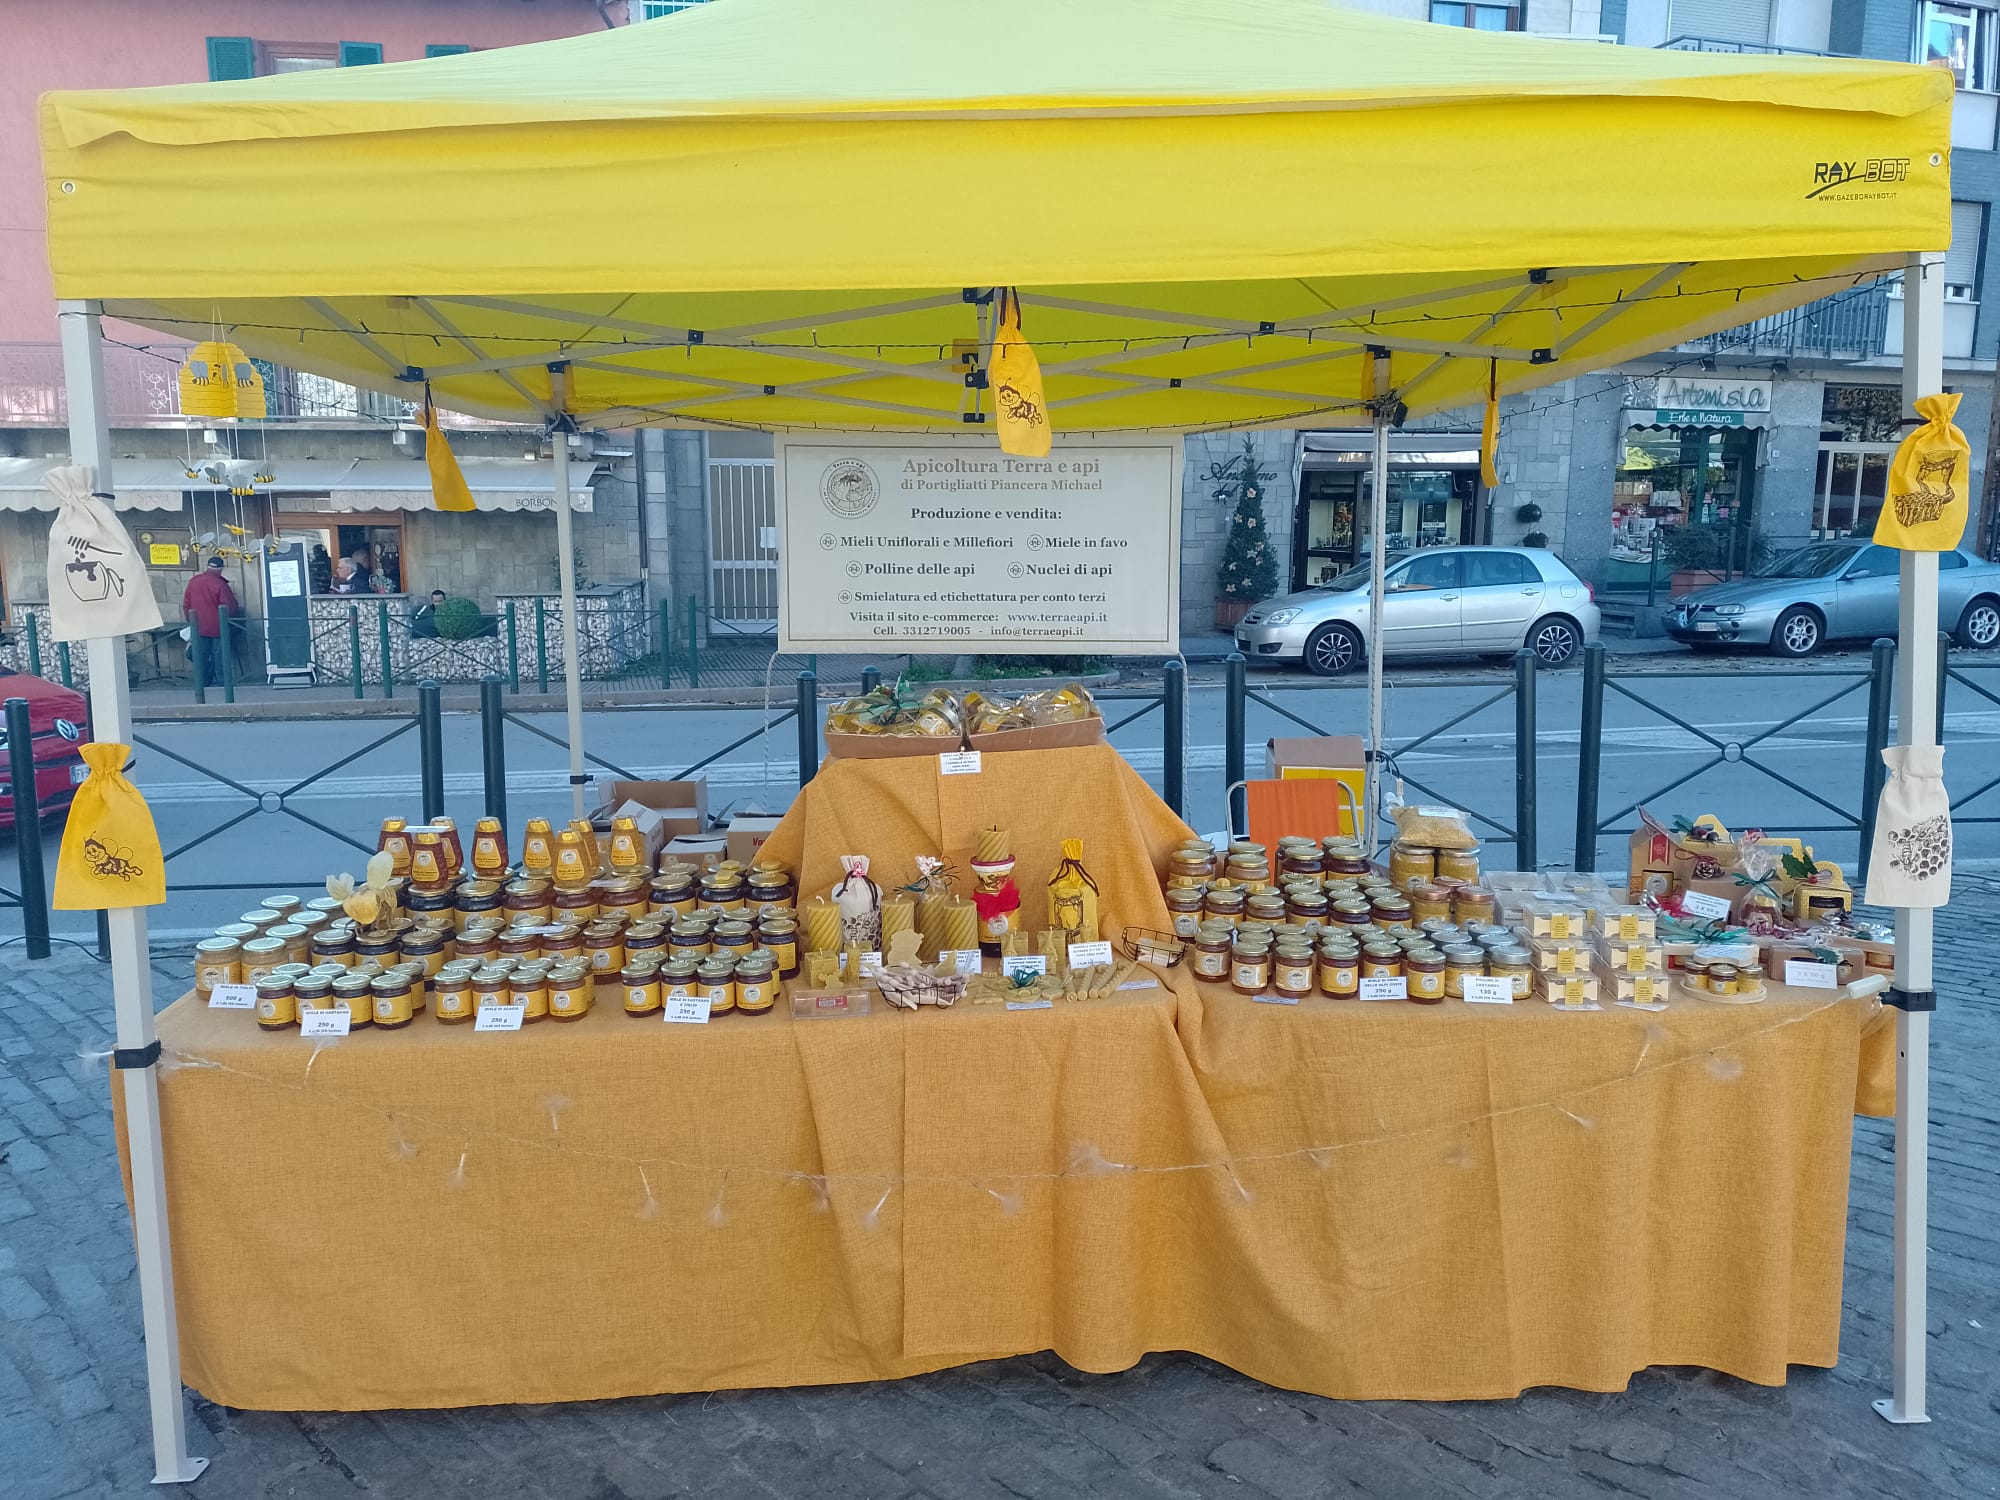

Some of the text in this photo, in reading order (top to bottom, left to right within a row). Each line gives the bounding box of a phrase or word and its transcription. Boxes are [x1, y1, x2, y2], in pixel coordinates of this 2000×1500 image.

[1814, 158, 1911, 184] RAY BOT
[1664, 378, 1766, 408] Artemisia
[1691, 415, 1698, 423] e
[1699, 411, 1734, 424] Natura
[902, 457, 1101, 476] Apicoltura Terra e api
[900, 479, 1103, 493] di Portigliatti Piancera Michael
[515, 498, 558, 508] BORBON
[910, 507, 1063, 520] Produzione e vendita:
[839, 535, 1014, 548] Mieli Uniflorali e Millefiori
[1044, 536, 1128, 549] Miele in favo
[863, 562, 976, 579] Polline delle api
[1025, 563, 1113, 579] Nuclei di api
[854, 591, 1106, 606] Smielatura ed etichettatura per conto terzi
[849, 611, 1108, 626] Visita il sito e-commerce: www.terraeapi.it
[873, 626, 898, 636] Cell.
[902, 626, 971, 637] 3312719005
[990, 626, 1084, 639] info@terraeapi.it
